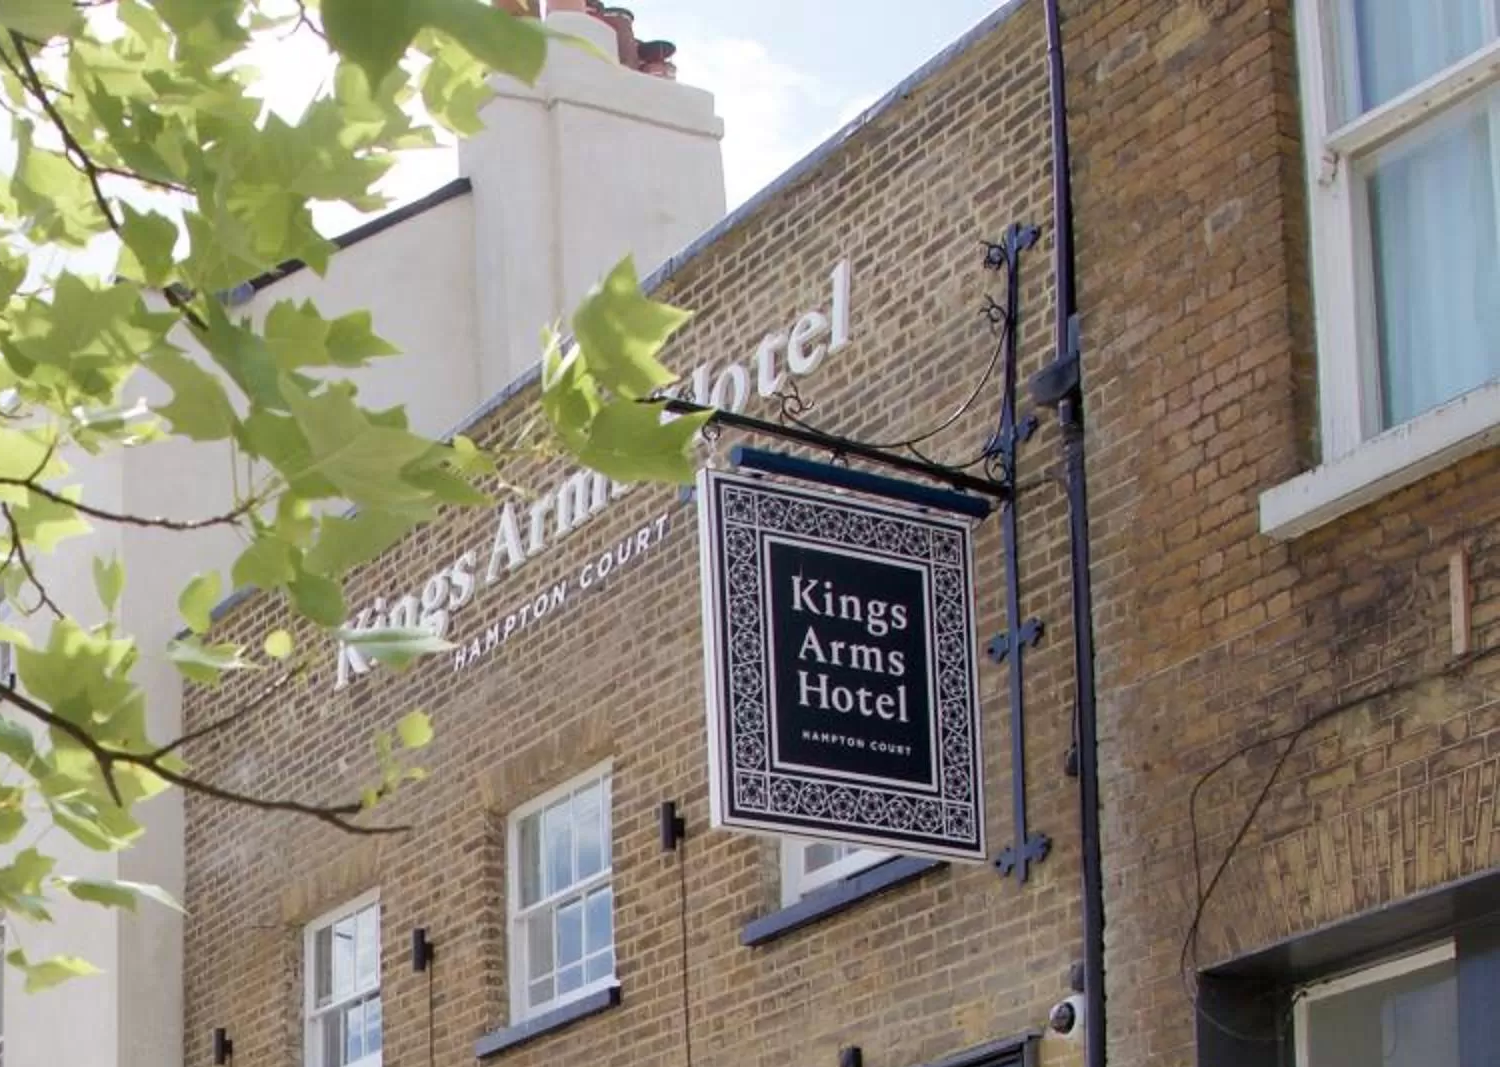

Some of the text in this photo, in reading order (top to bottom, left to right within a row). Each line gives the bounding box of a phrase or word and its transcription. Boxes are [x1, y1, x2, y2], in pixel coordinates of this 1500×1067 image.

[485, 467, 629, 583] Arm
[454, 514, 671, 672] HAMPTON COURT
[791, 575, 908, 637] Kings
[798, 625, 905, 677] Arms
[797, 669, 910, 723] Hotel
[802, 731, 912, 757] HAMPTON COURT
